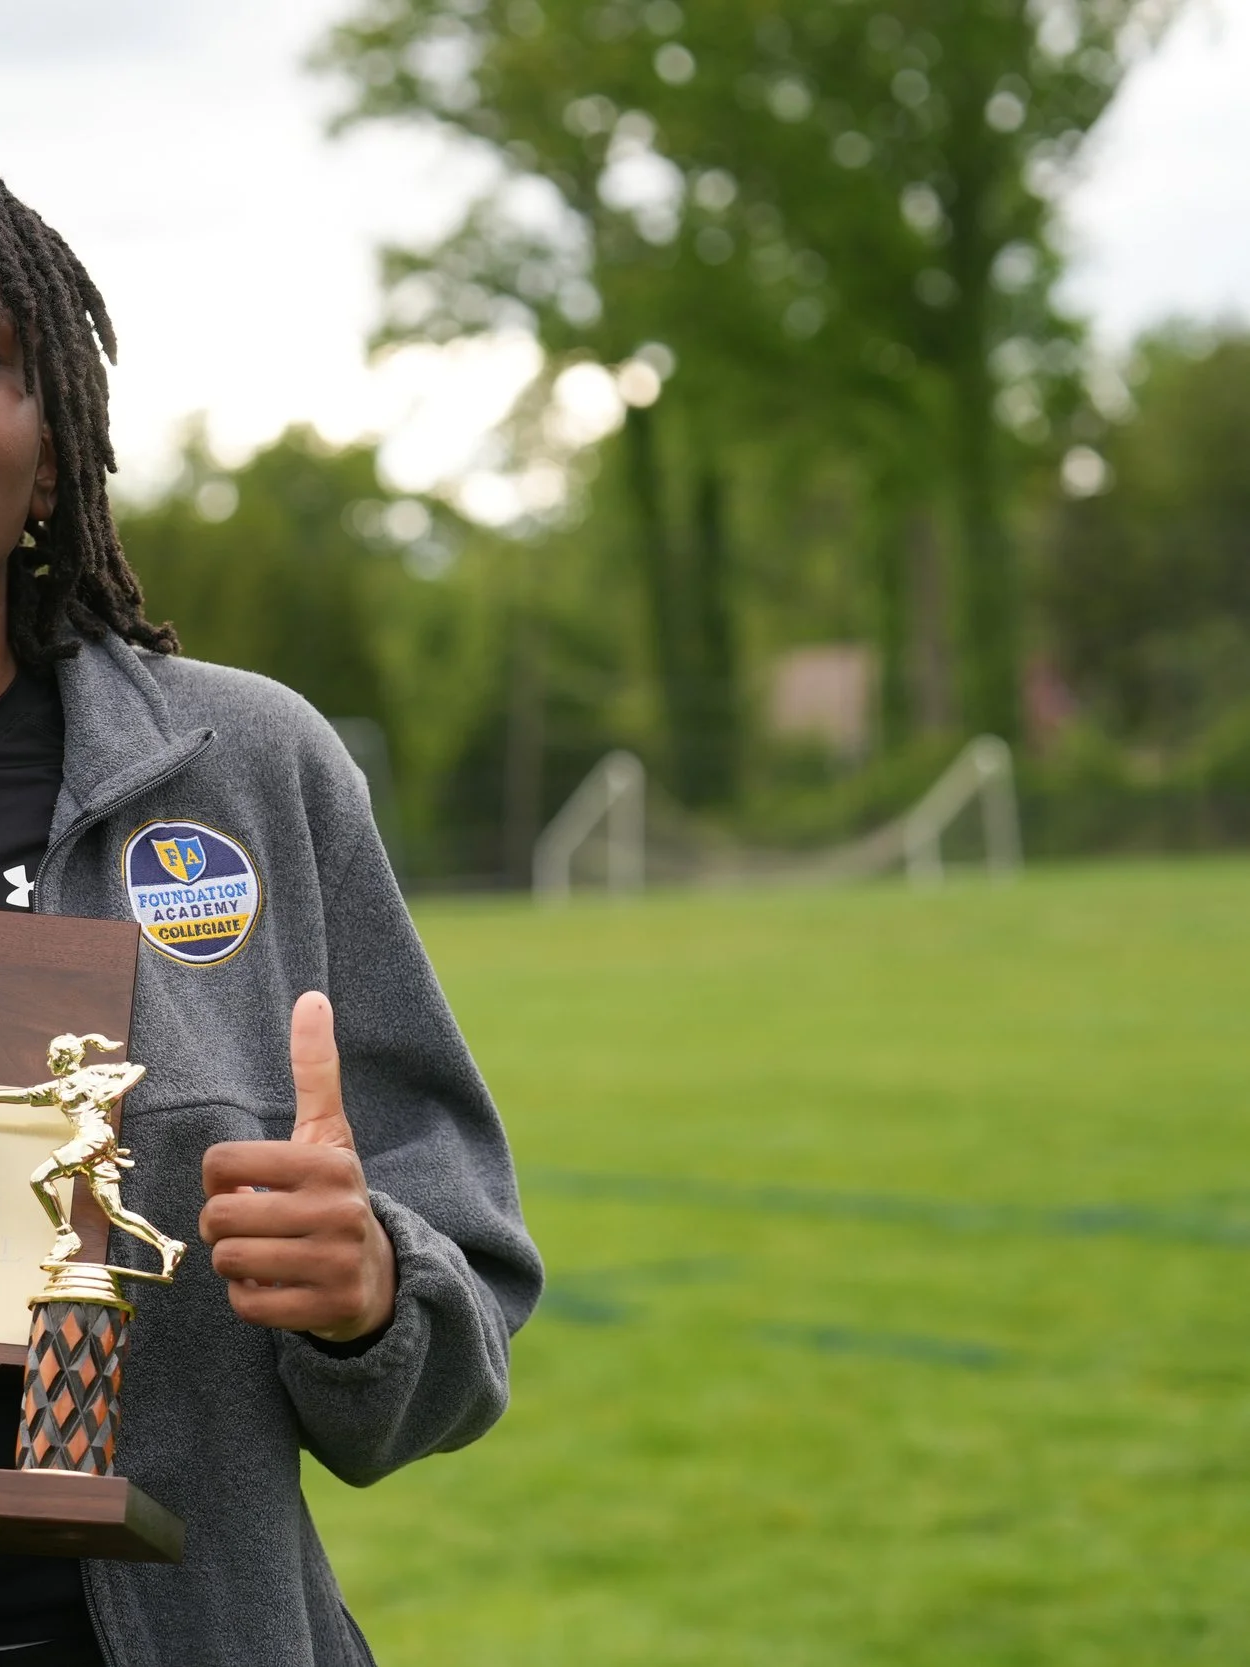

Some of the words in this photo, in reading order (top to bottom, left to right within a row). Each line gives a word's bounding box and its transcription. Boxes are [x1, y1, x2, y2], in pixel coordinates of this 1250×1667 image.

[138, 882, 247, 908] FOUNDATION
[154, 900, 238, 922] ACADEMY
[158, 919, 241, 939] COLLEGIATE
